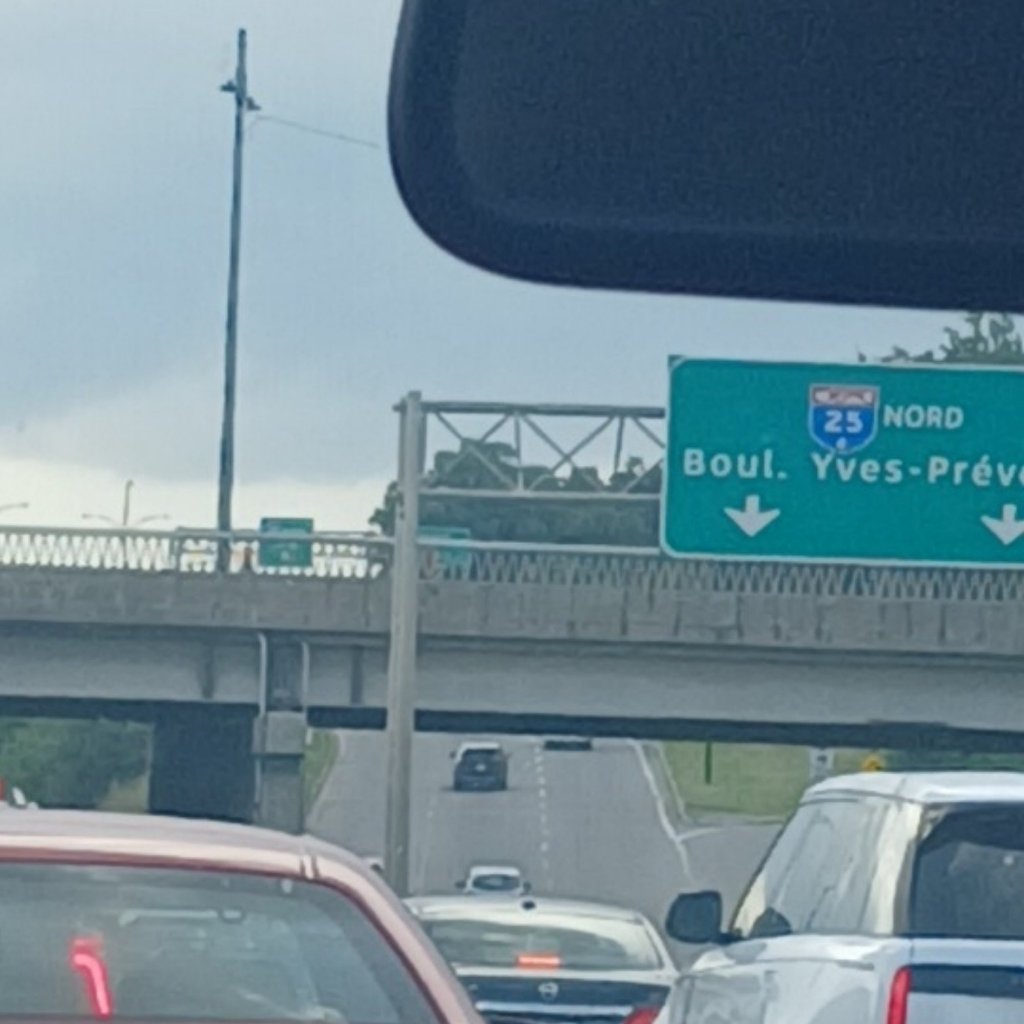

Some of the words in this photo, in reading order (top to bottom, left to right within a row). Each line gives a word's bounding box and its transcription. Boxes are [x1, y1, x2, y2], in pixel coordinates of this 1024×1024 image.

[824, 410, 864, 434] 25
[883, 404, 964, 430] NORD
[682, 448, 788, 480] Boul.
